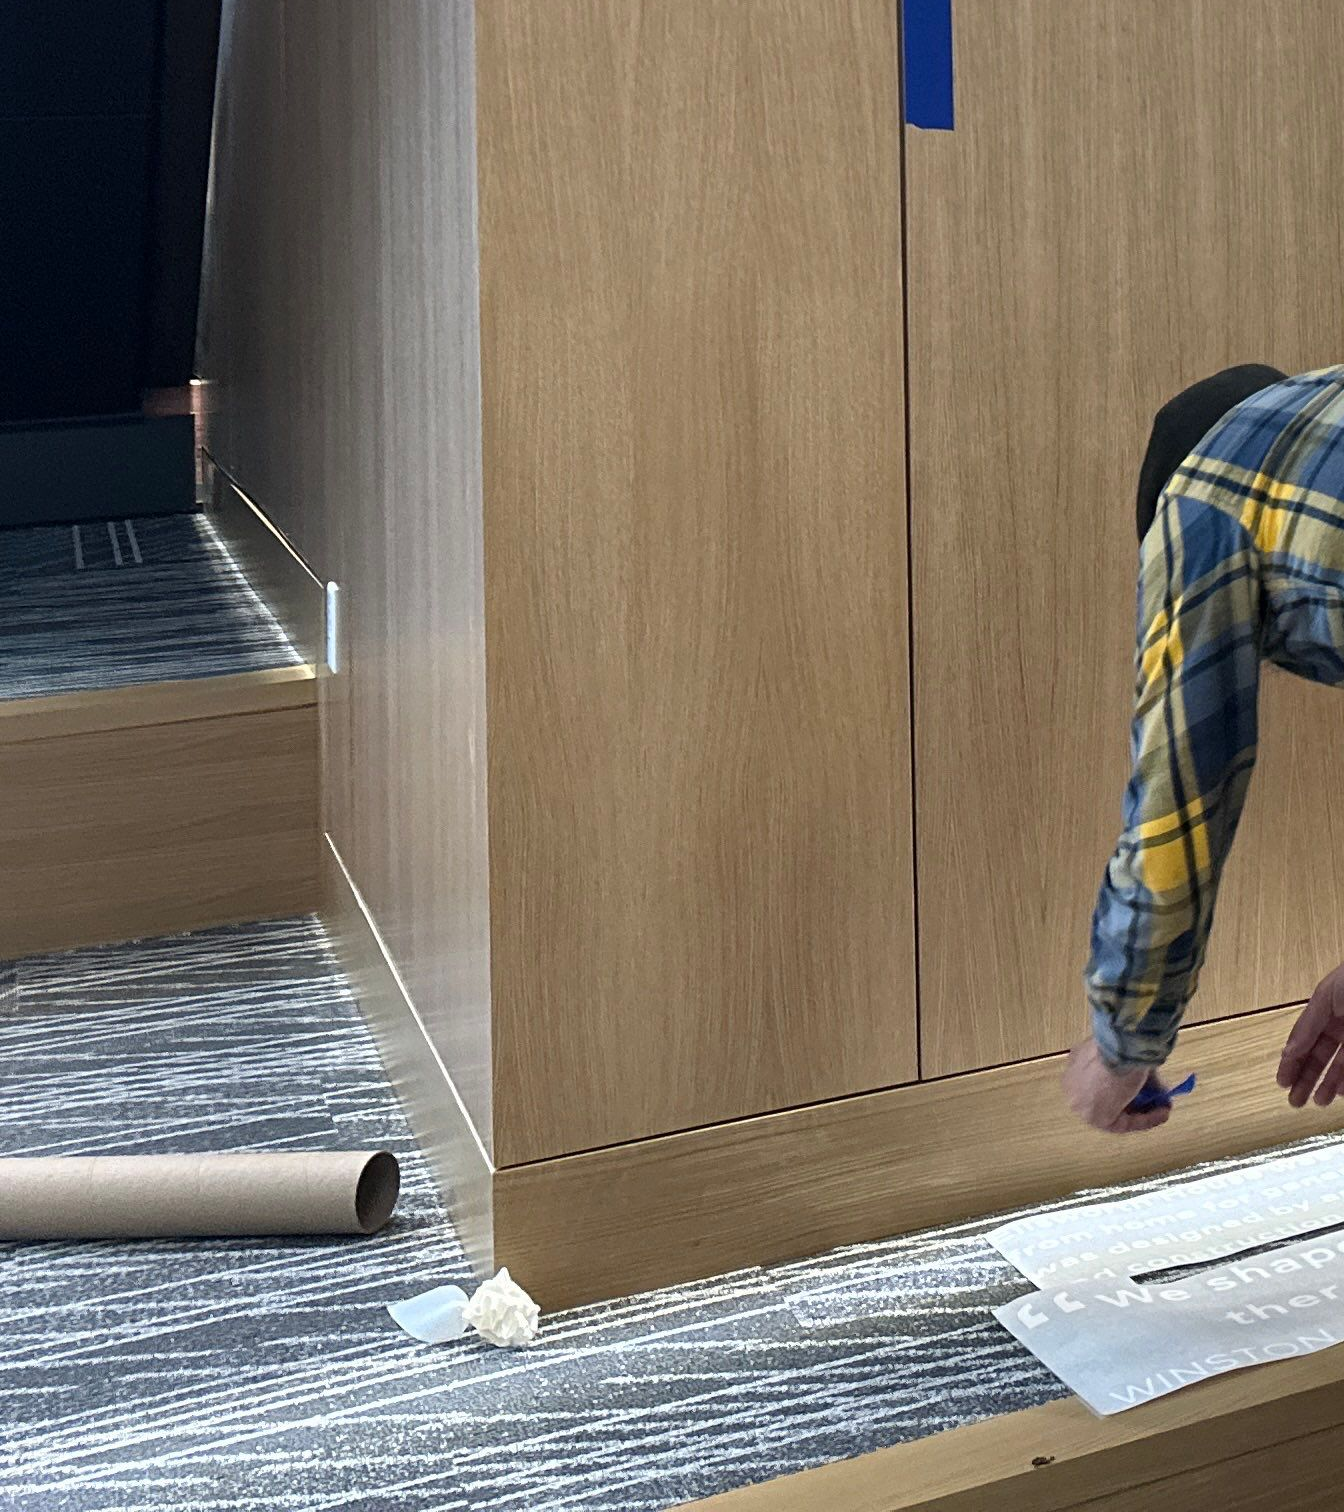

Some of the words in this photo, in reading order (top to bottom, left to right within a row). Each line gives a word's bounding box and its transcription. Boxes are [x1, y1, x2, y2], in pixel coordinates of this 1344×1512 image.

[1034, 1250, 1099, 1280] was
[1107, 1209, 1265, 1256] designed
[1268, 1198, 1311, 1218] by
[1099, 1207, 1198, 1237] home
[1202, 1192, 1251, 1215] for
[1108, 1327, 1335, 1406] WINSTON
